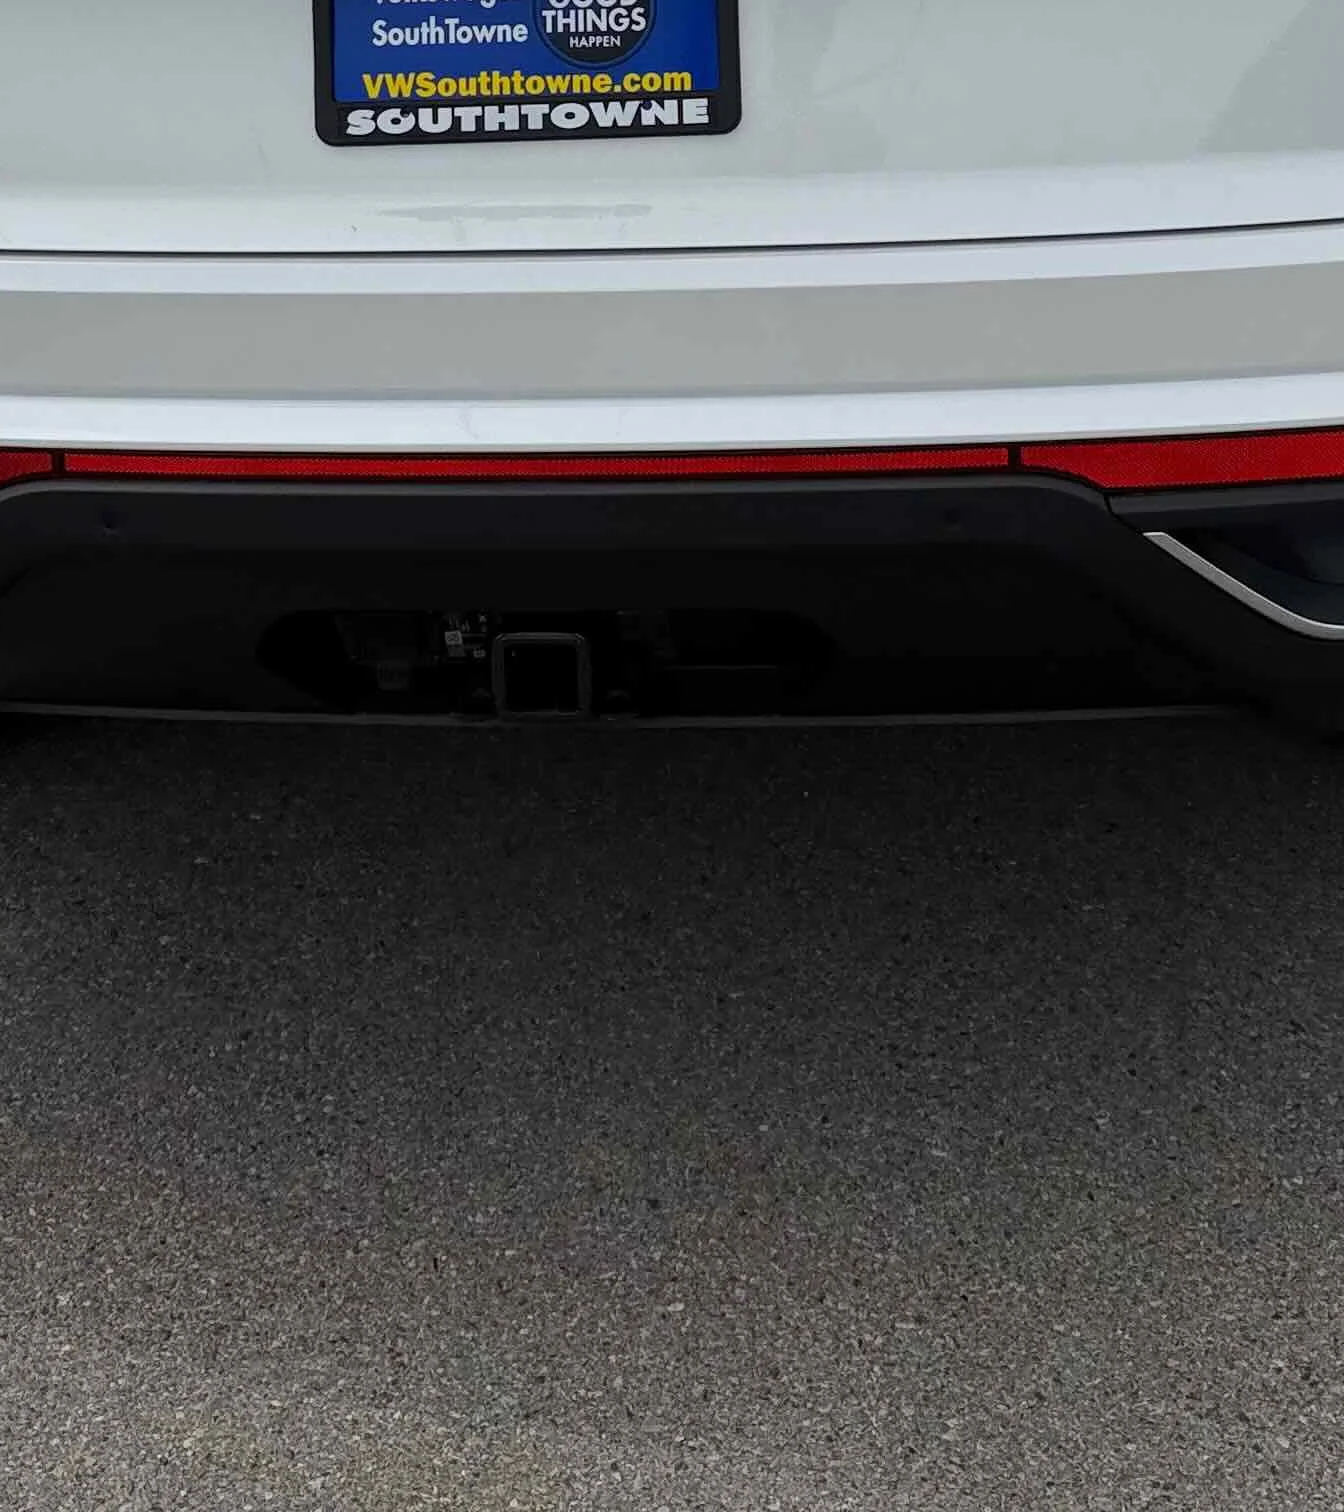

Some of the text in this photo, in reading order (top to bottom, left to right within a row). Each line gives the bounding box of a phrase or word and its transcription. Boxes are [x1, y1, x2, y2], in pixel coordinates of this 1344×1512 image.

[371, 16, 529, 47] SouthTowne
[541, 7, 647, 34] THINGS
[568, 35, 622, 50] HAPPEN
[362, 69, 693, 100] VWSouthtowne.com
[345, 97, 710, 137] SOUTHTOWNE
